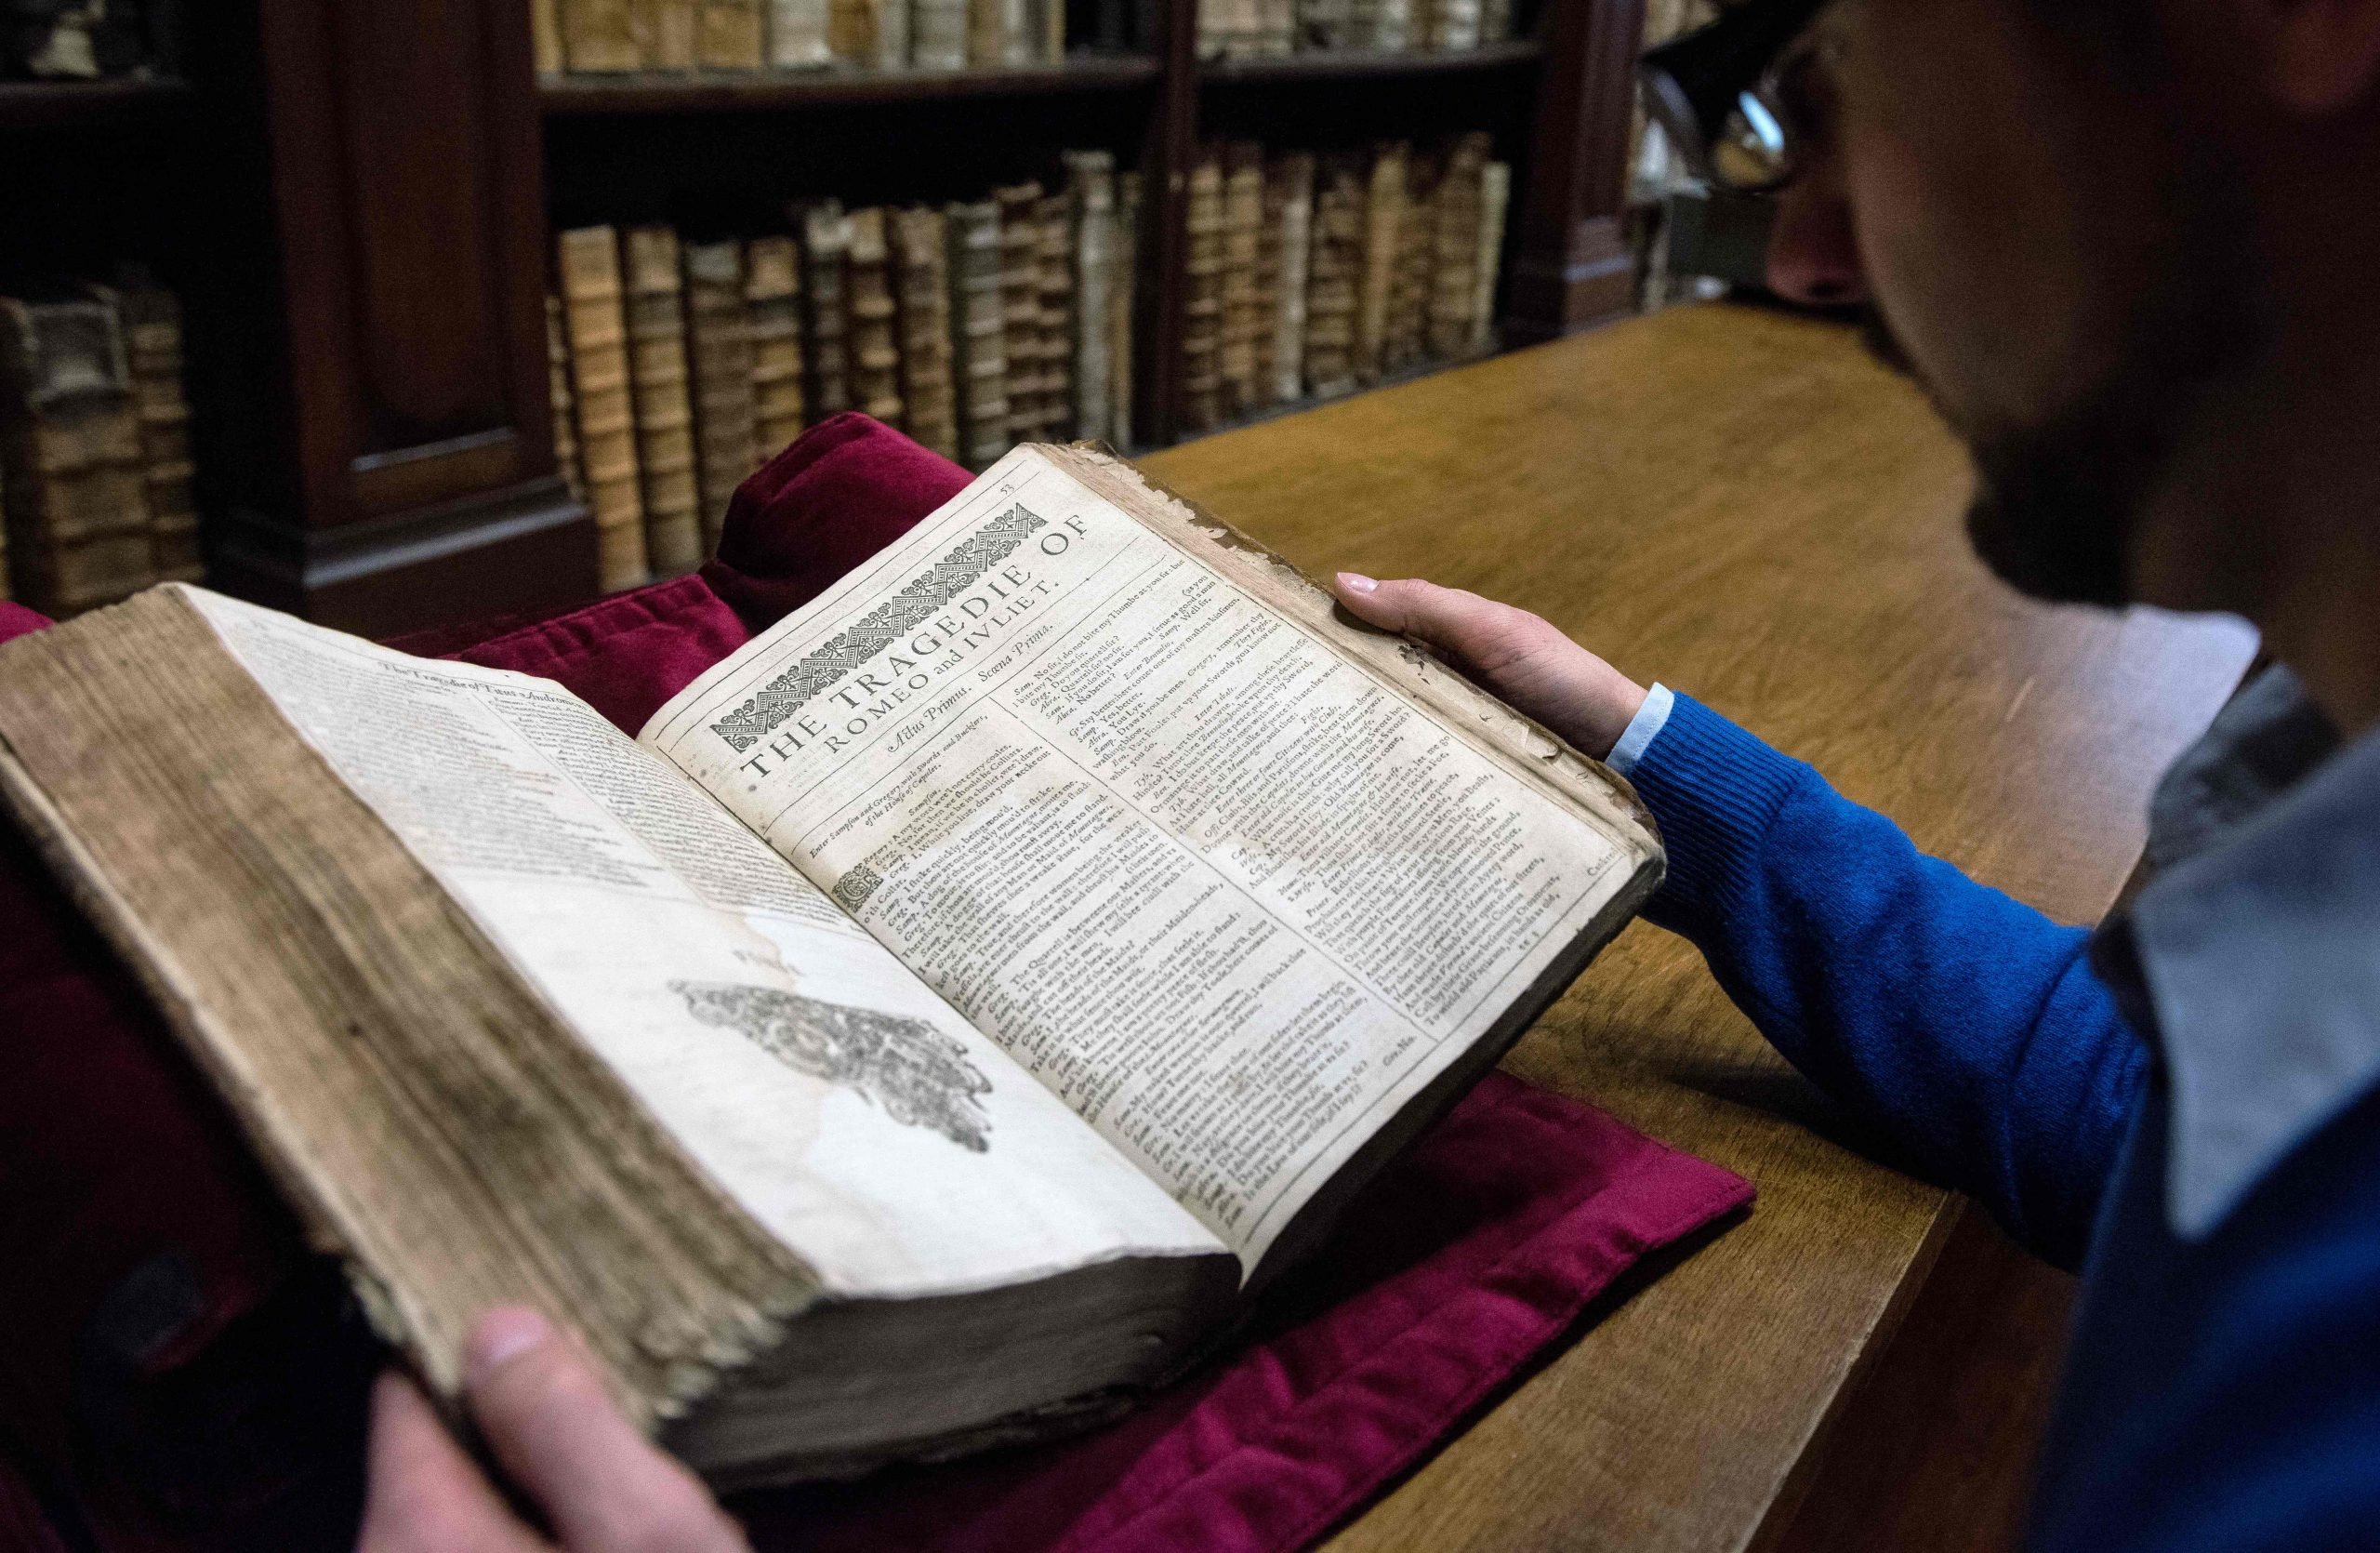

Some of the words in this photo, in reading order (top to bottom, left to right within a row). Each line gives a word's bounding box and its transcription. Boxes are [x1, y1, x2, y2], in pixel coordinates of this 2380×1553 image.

[999, 484, 1014, 495] 53
[739, 714, 826, 777] THE
[827, 564, 1031, 709] TRAGEDIE
[1040, 514, 1087, 555] OF
[823, 673, 929, 753] ROMEO
[932, 648, 964, 674] and
[962, 579, 1059, 650] IVLIET.
[922, 687, 972, 721] Primus.
[1011, 625, 1052, 656] Prima.
